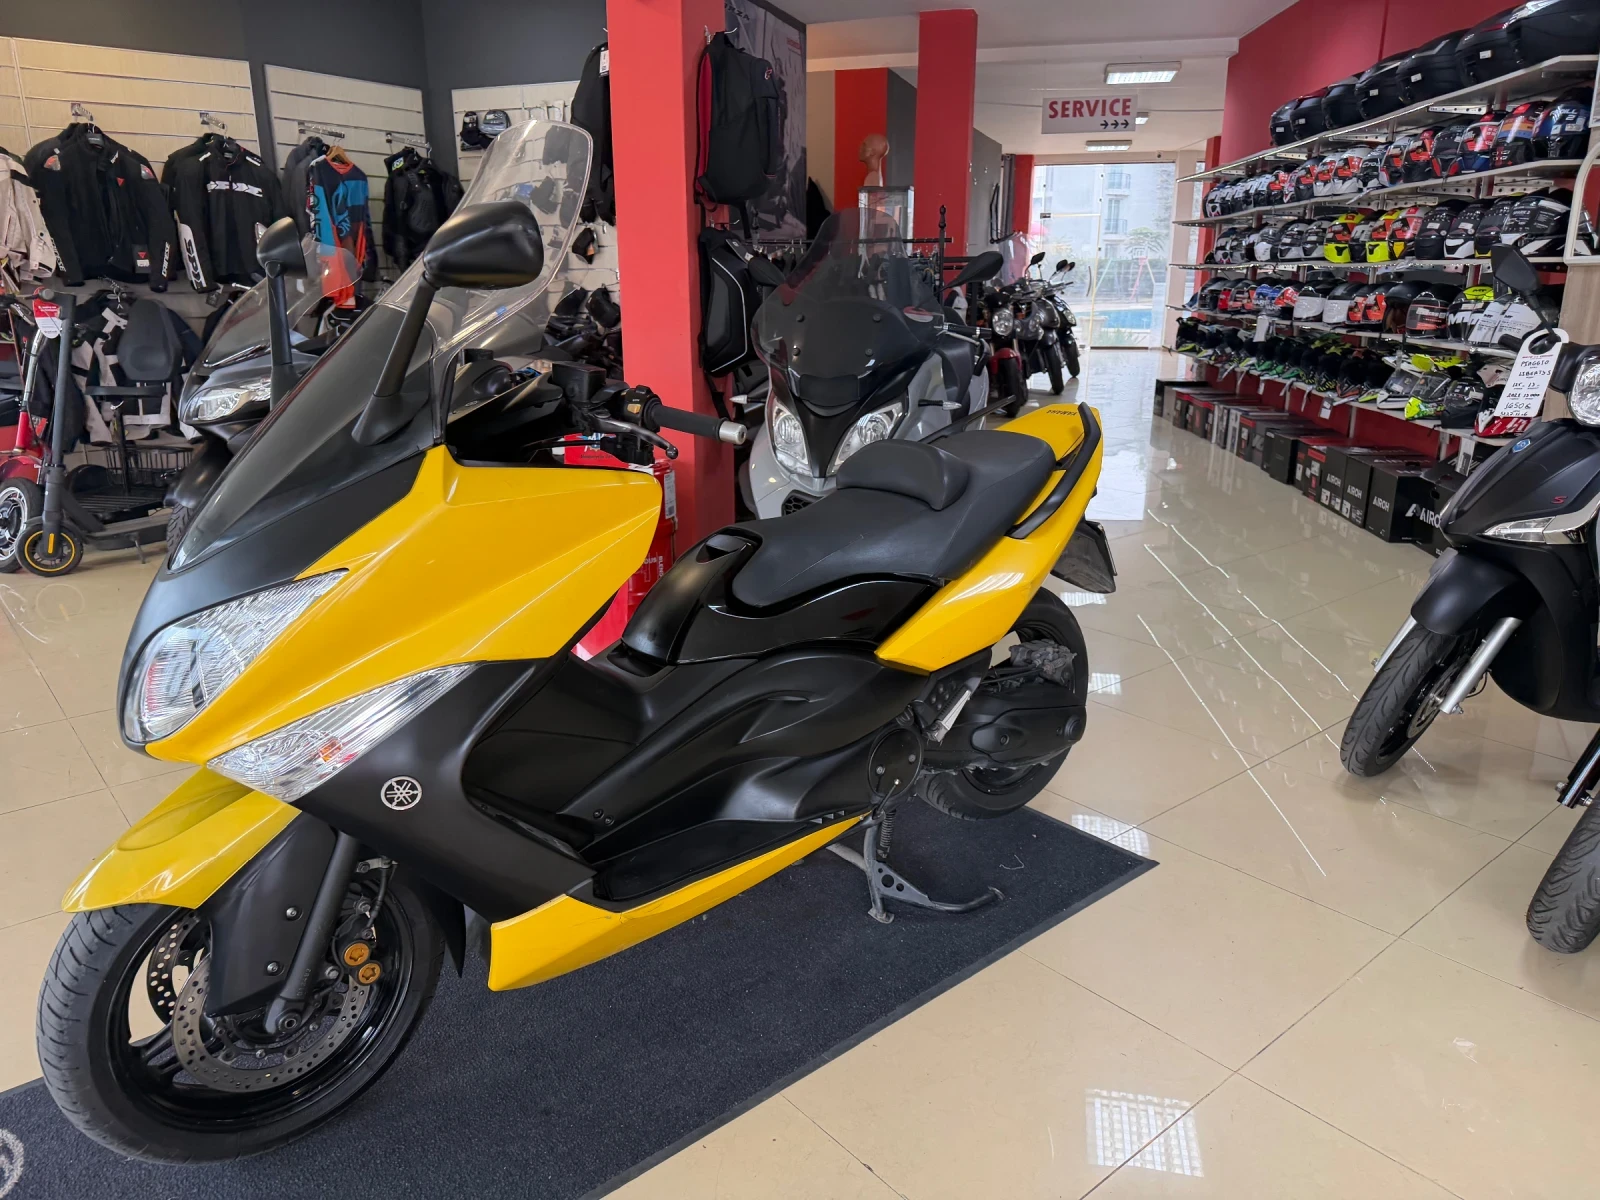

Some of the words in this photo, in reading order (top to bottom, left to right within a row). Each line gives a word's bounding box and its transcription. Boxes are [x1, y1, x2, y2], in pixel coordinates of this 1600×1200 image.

[1048, 98, 1132, 119] SERVICE
[1326, 473, 1342, 488] AIROH
[1346, 484, 1363, 500] AIROH
[1550, 495, 1568, 504] S
[1372, 496, 1390, 513] AIROH
[1419, 507, 1441, 529] AIRO
